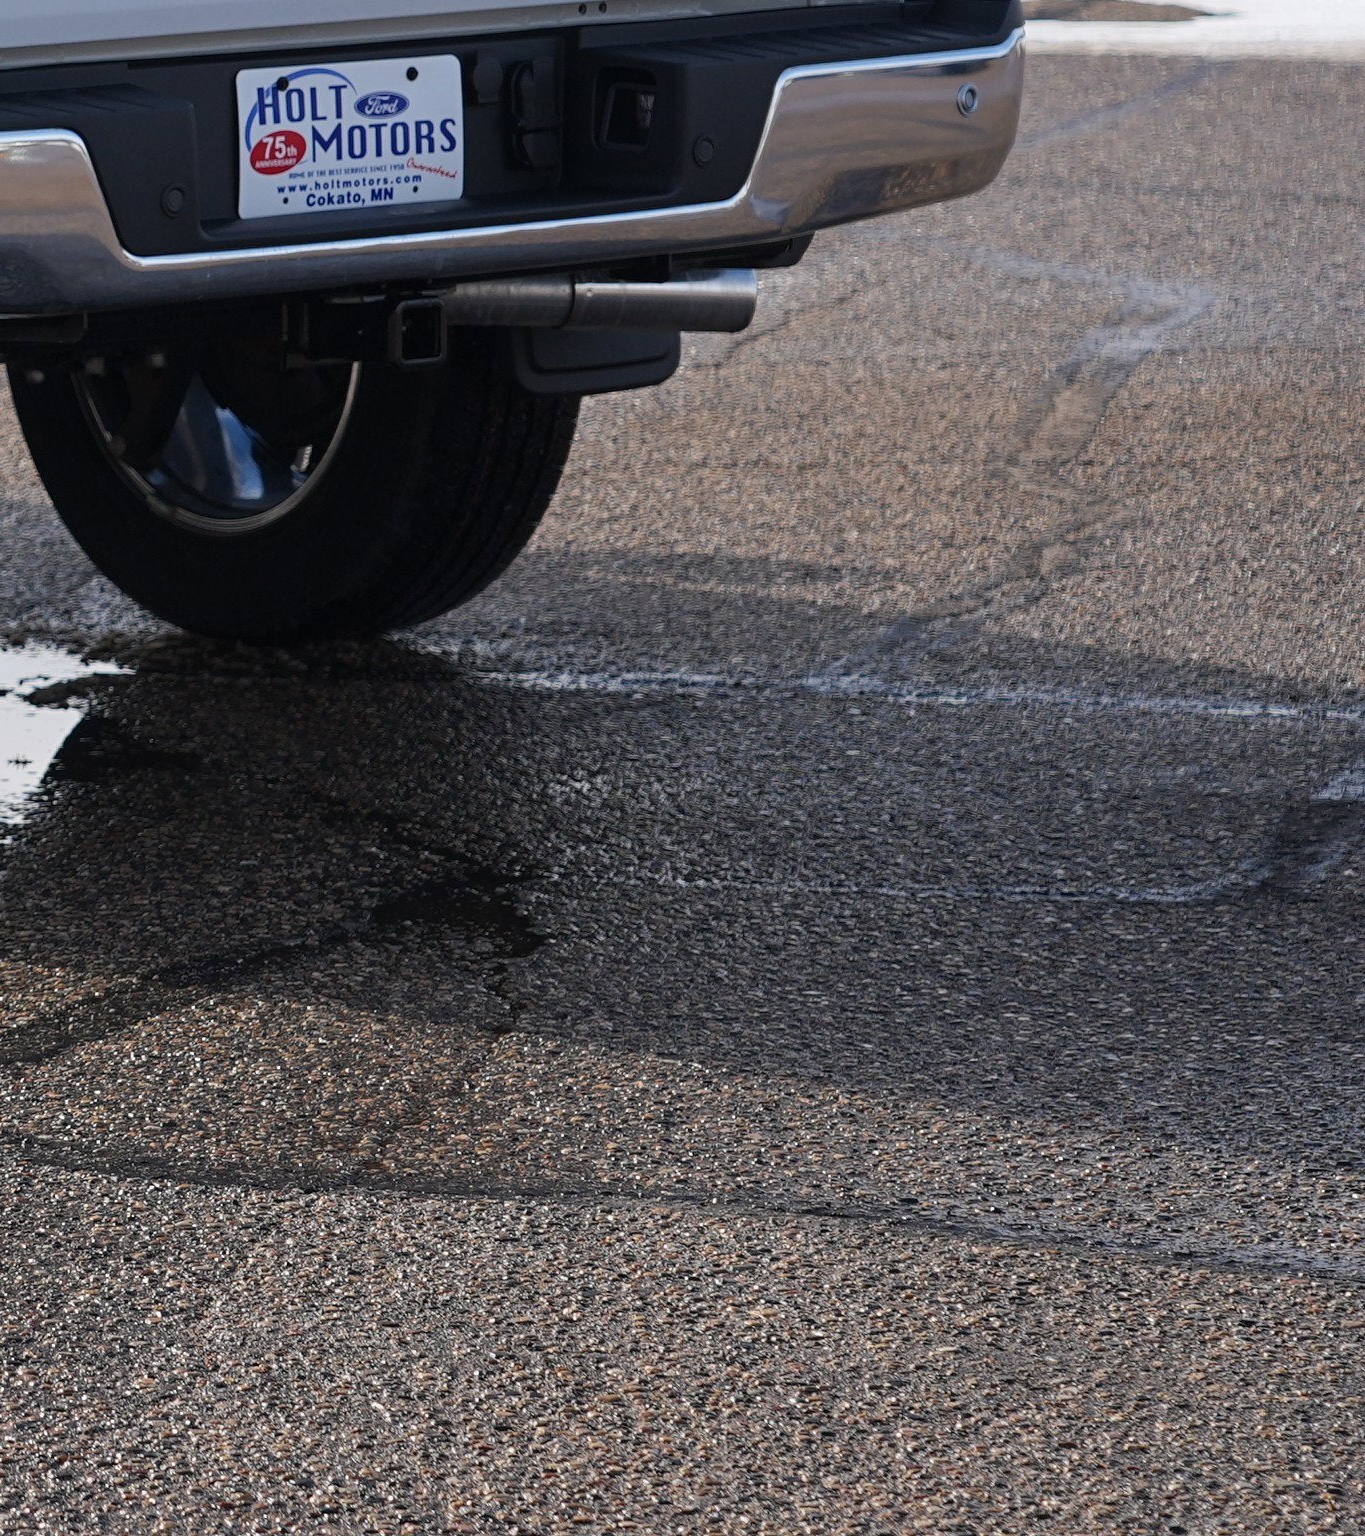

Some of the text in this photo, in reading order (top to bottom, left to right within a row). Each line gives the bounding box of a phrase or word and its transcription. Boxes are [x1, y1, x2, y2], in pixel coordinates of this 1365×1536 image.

[258, 85, 347, 125] HOLT
[363, 94, 400, 115] Ford
[262, 135, 298, 160] 75th
[311, 117, 458, 163] MOTORS
[254, 157, 298, 169] ANNIVERSARY
[288, 171, 305, 179] HOME
[316, 169, 327, 177] THE
[328, 168, 342, 176] BEST
[343, 166, 368, 175] SERVICE
[370, 164, 387, 172] SINCE
[277, 173, 422, 194] www.holtmotors.com
[306, 187, 394, 207] Cokato, MN
